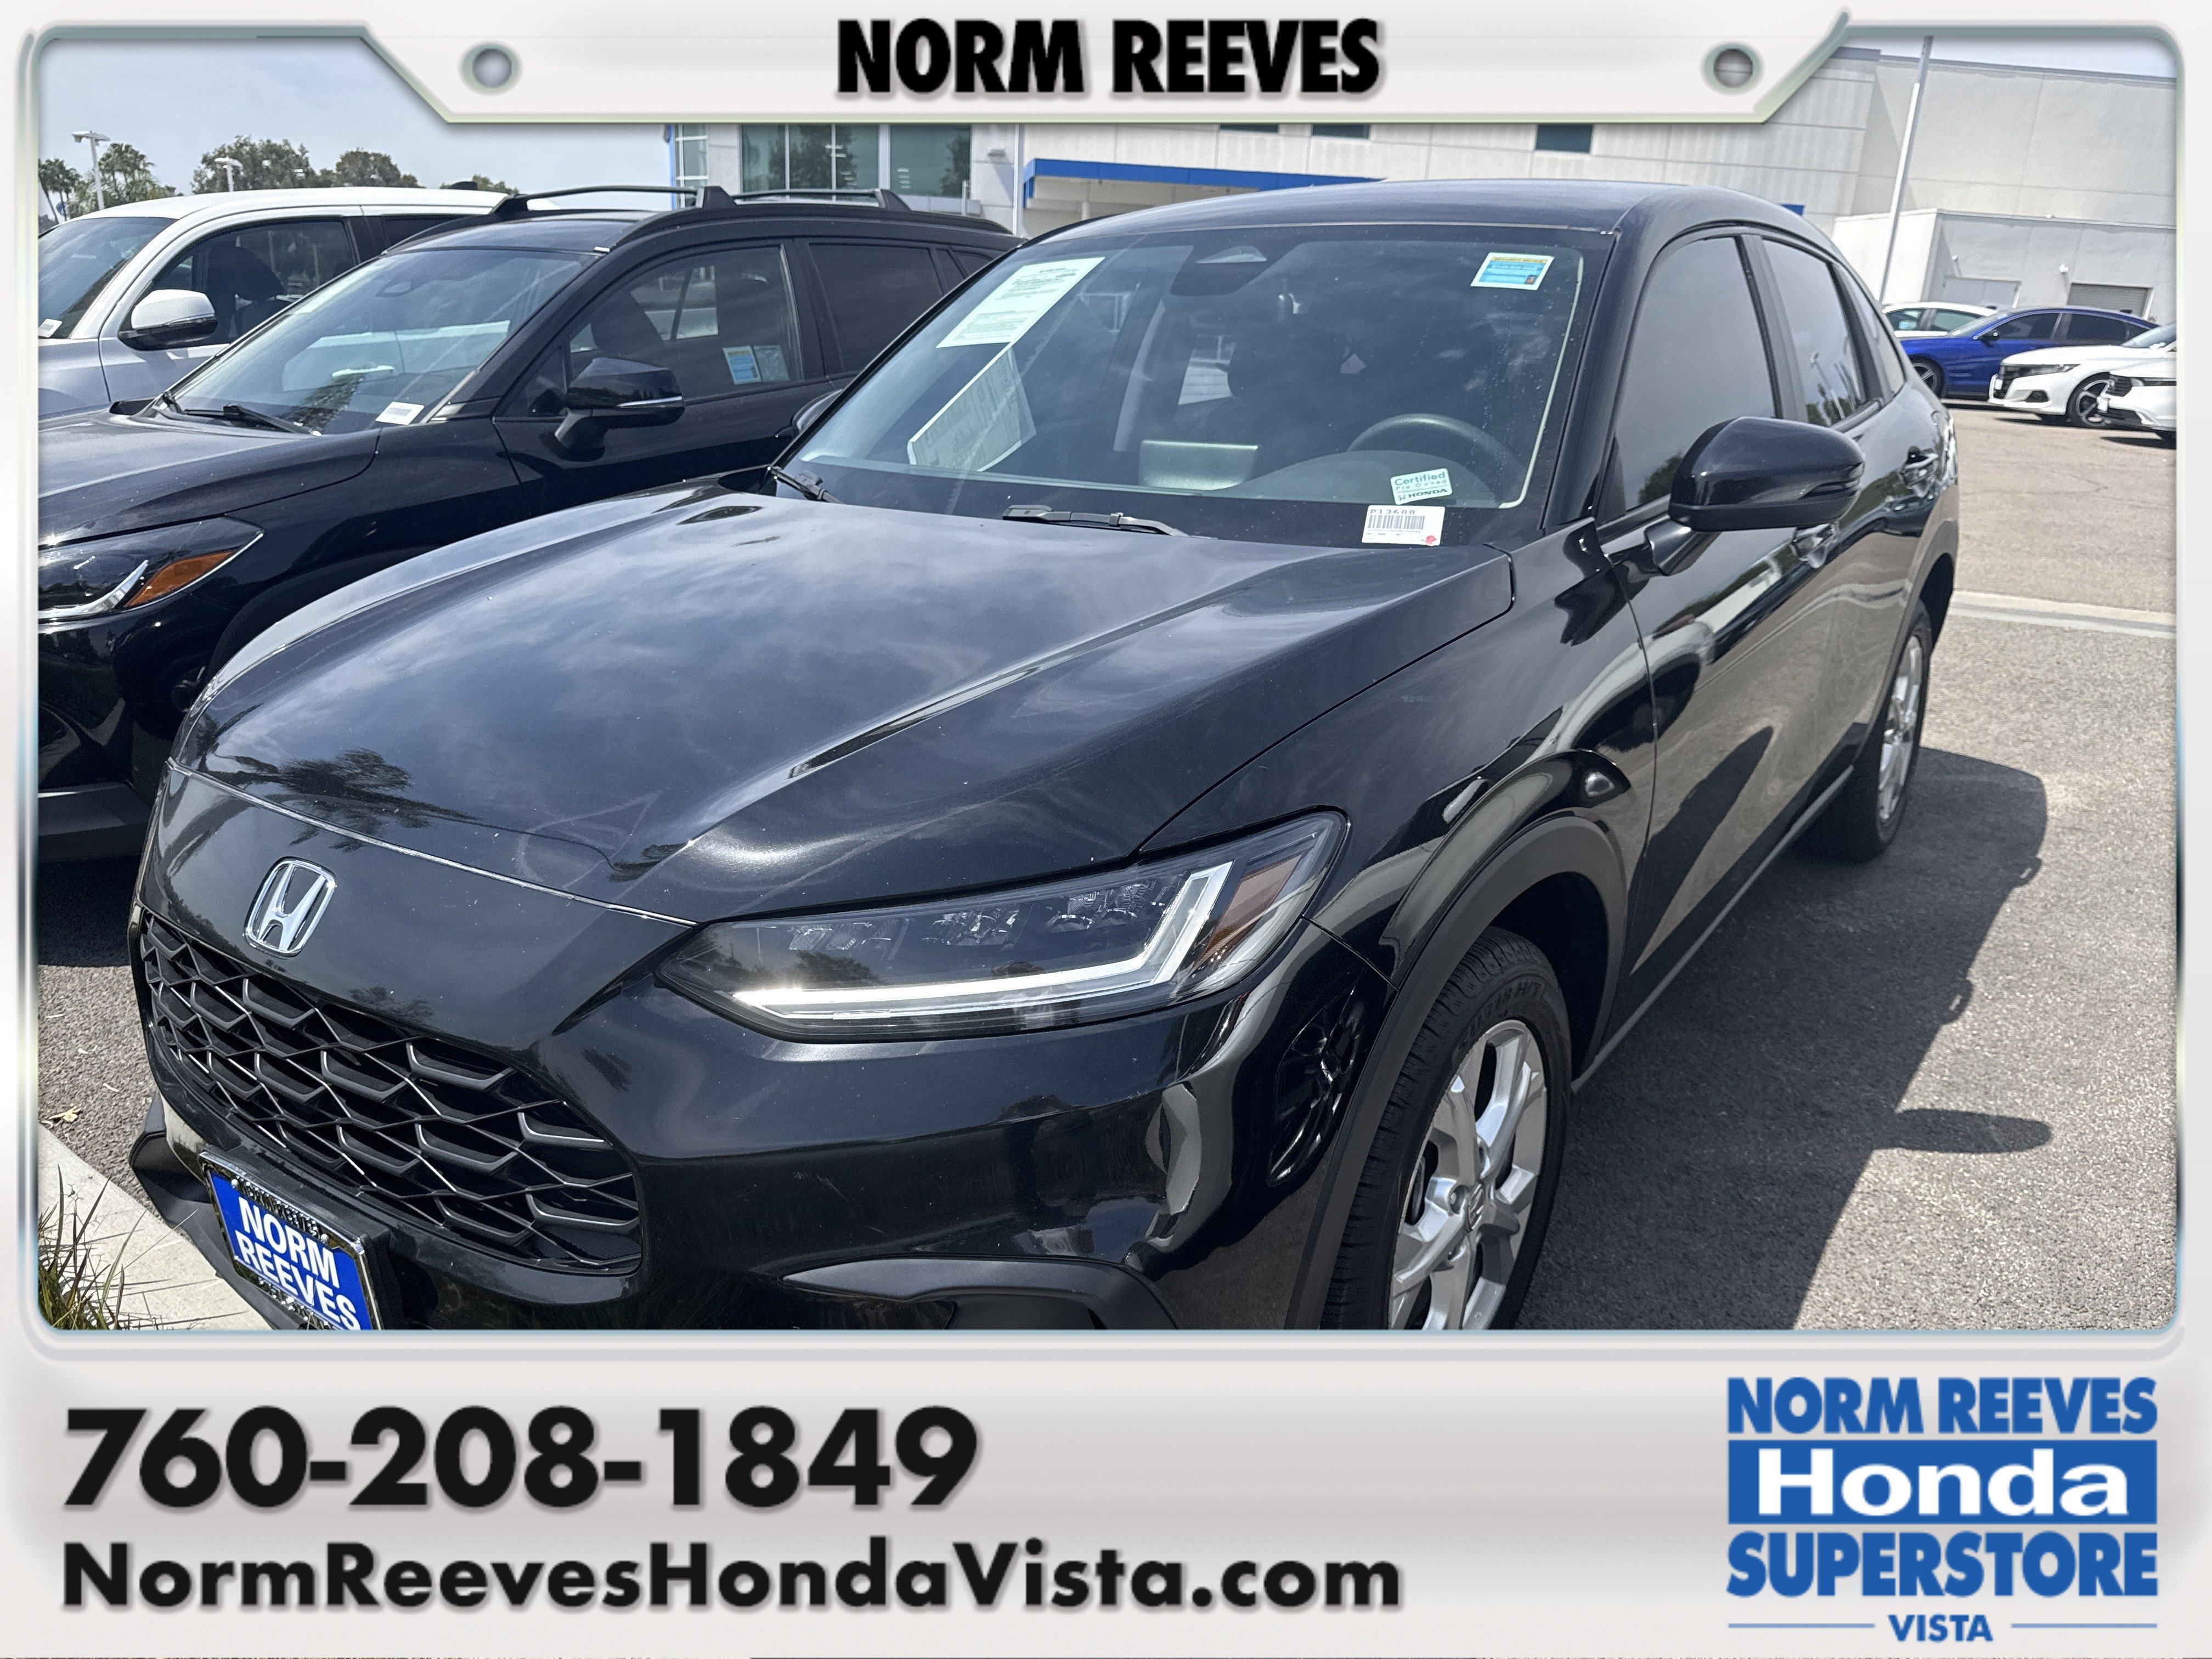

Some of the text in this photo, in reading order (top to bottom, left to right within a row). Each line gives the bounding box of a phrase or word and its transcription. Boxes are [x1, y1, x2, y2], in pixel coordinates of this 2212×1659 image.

[1394, 471, 1446, 486] Certified
[1408, 488, 1448, 498] HONDA
[238, 1196, 340, 1289] NORM
[234, 1229, 362, 1330] REEVES
